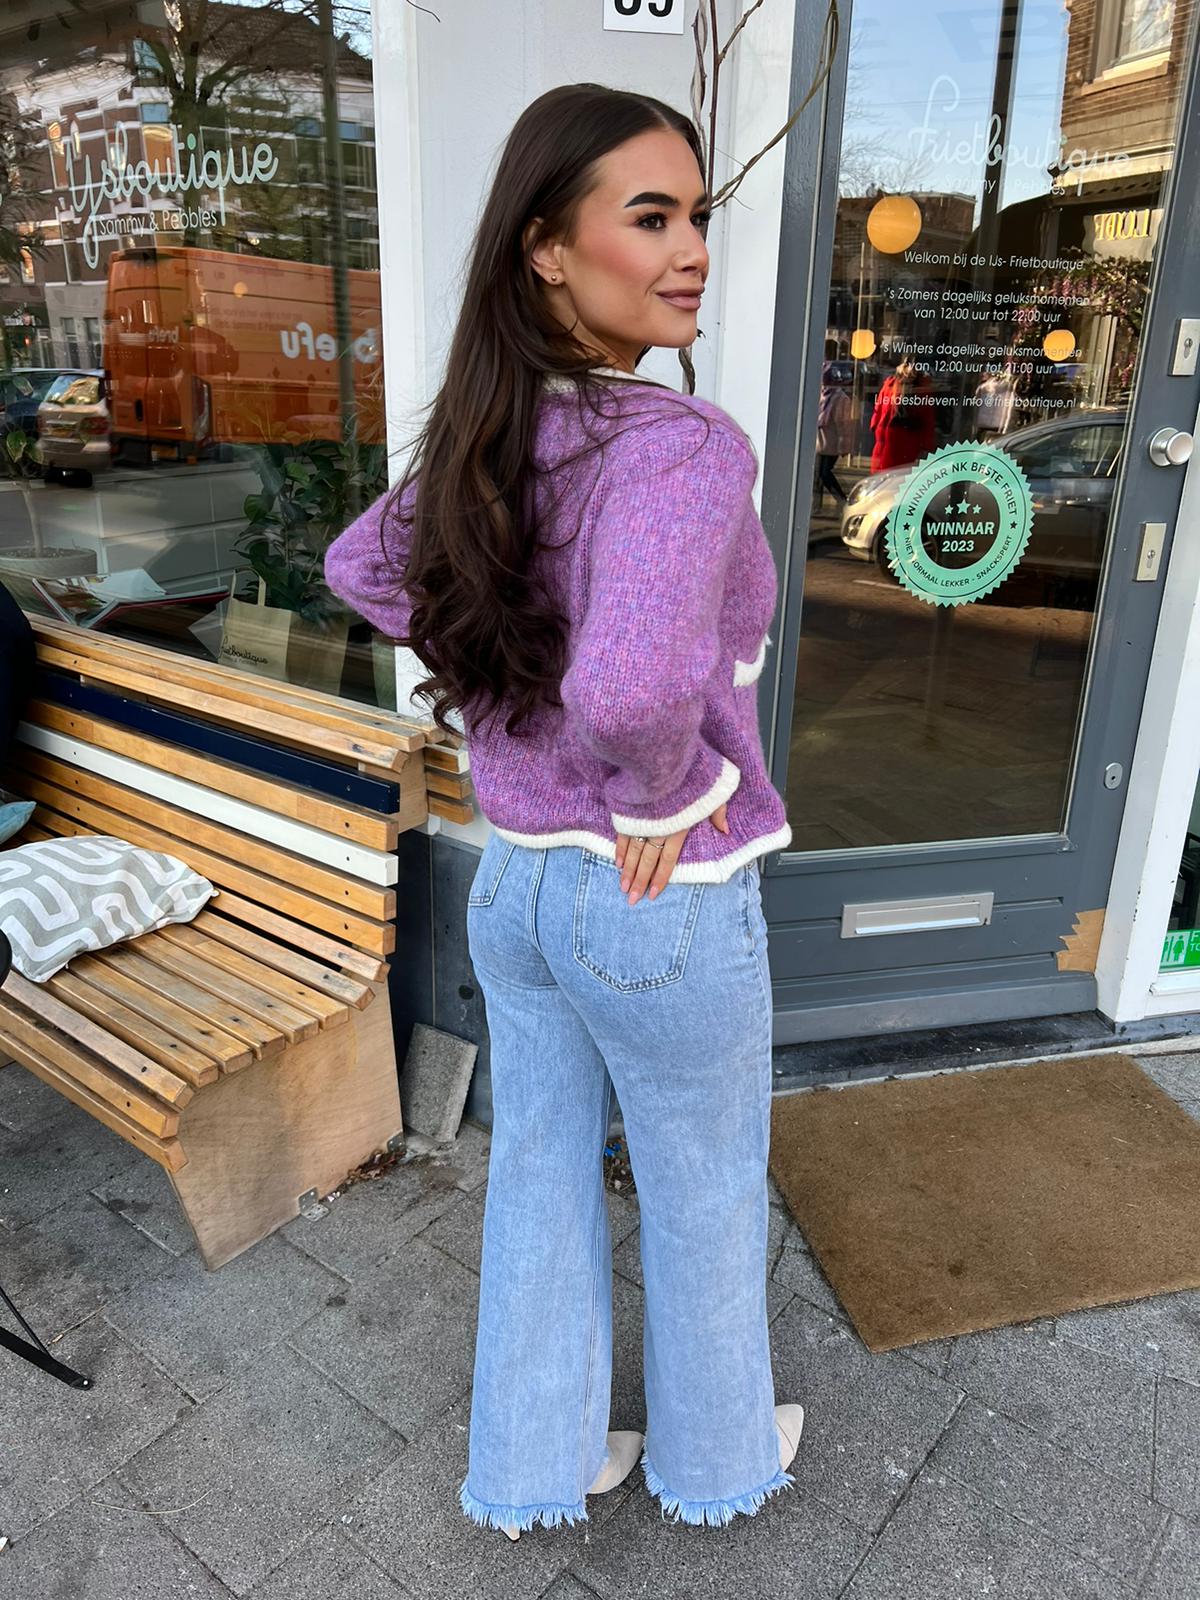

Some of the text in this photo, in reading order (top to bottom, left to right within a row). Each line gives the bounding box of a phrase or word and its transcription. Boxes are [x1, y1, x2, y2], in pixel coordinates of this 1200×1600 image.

[99, 206, 217, 236] Sammy & Pebbles
[904, 251, 950, 265] Welkom
[953, 253, 967, 267] bij
[970, 253, 986, 266] de
[1009, 255, 1084, 271] Frietboutique
[897, 287, 939, 300] Zomers
[942, 289, 992, 304] dagelijks
[994, 291, 1090, 307] geluksmomenten
[914, 307, 1062, 323] van 12:00 uur tot 22:00 uur
[892, 341, 934, 354] Winters
[936, 343, 986, 358] dagelijks
[988, 344, 1083, 359] geluksmomenten
[908, 361, 930, 372] van
[934, 360, 963, 373] 12:00
[965, 362, 984, 373] uur
[985, 361, 1001, 374] tot
[1035, 364, 1054, 375] uur
[874, 394, 959, 407] Liefdesbrieven:
[906, 461, 1018, 517] WINNAAR NK BESTE FRIET
[926, 521, 995, 536] WINNAAR
[941, 540, 975, 553] 2023
[904, 537, 915, 557] NIET
[940, 579, 970, 588] LEKKER
[976, 535, 1013, 580] SNACKSPERT
